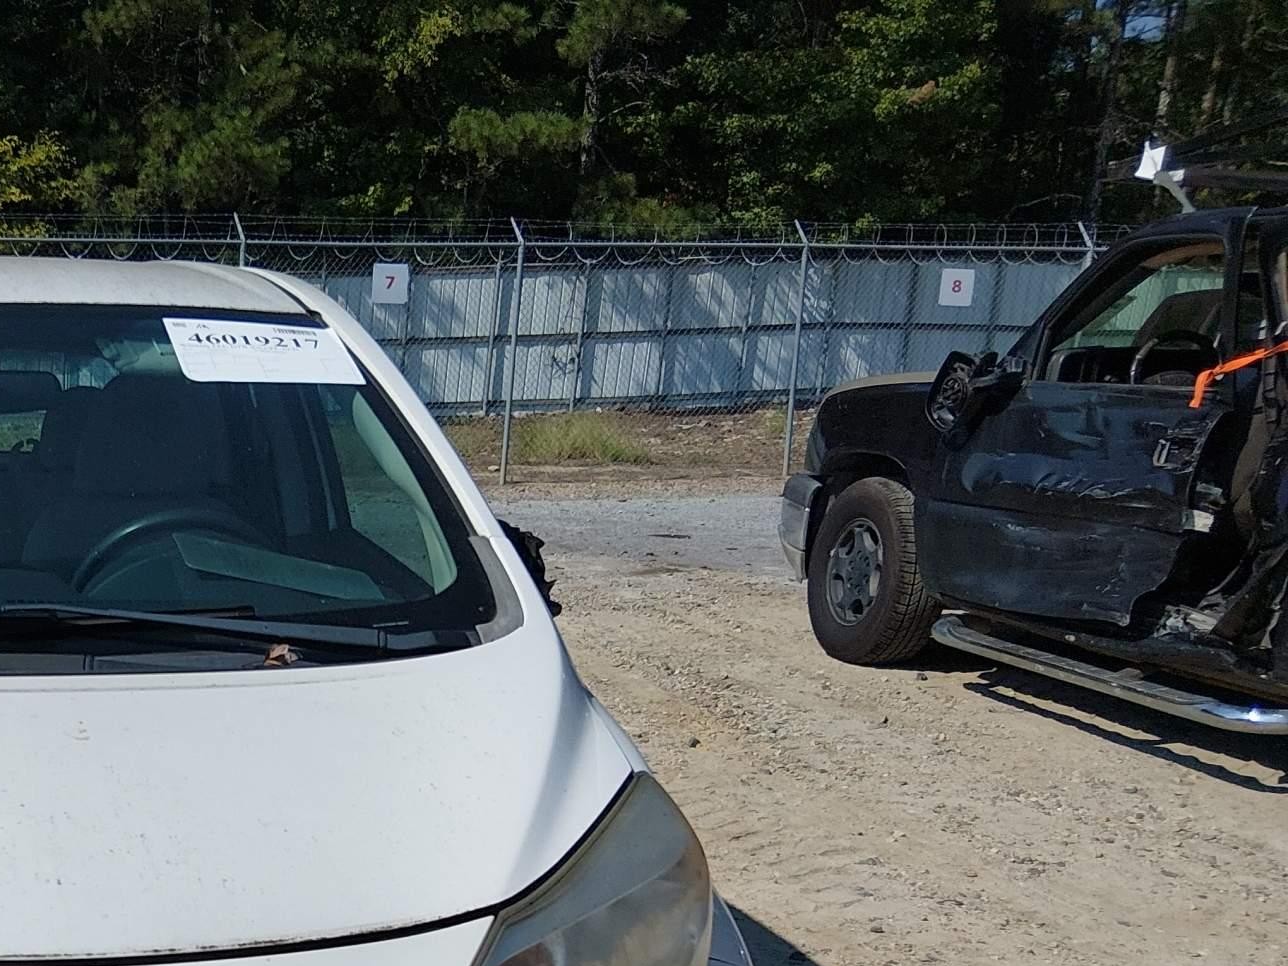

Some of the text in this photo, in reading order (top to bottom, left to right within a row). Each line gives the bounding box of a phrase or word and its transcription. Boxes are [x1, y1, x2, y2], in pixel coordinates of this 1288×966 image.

[385, 276, 395, 289] 7
[952, 280, 962, 293] 8
[187, 332, 319, 349] 46019217
